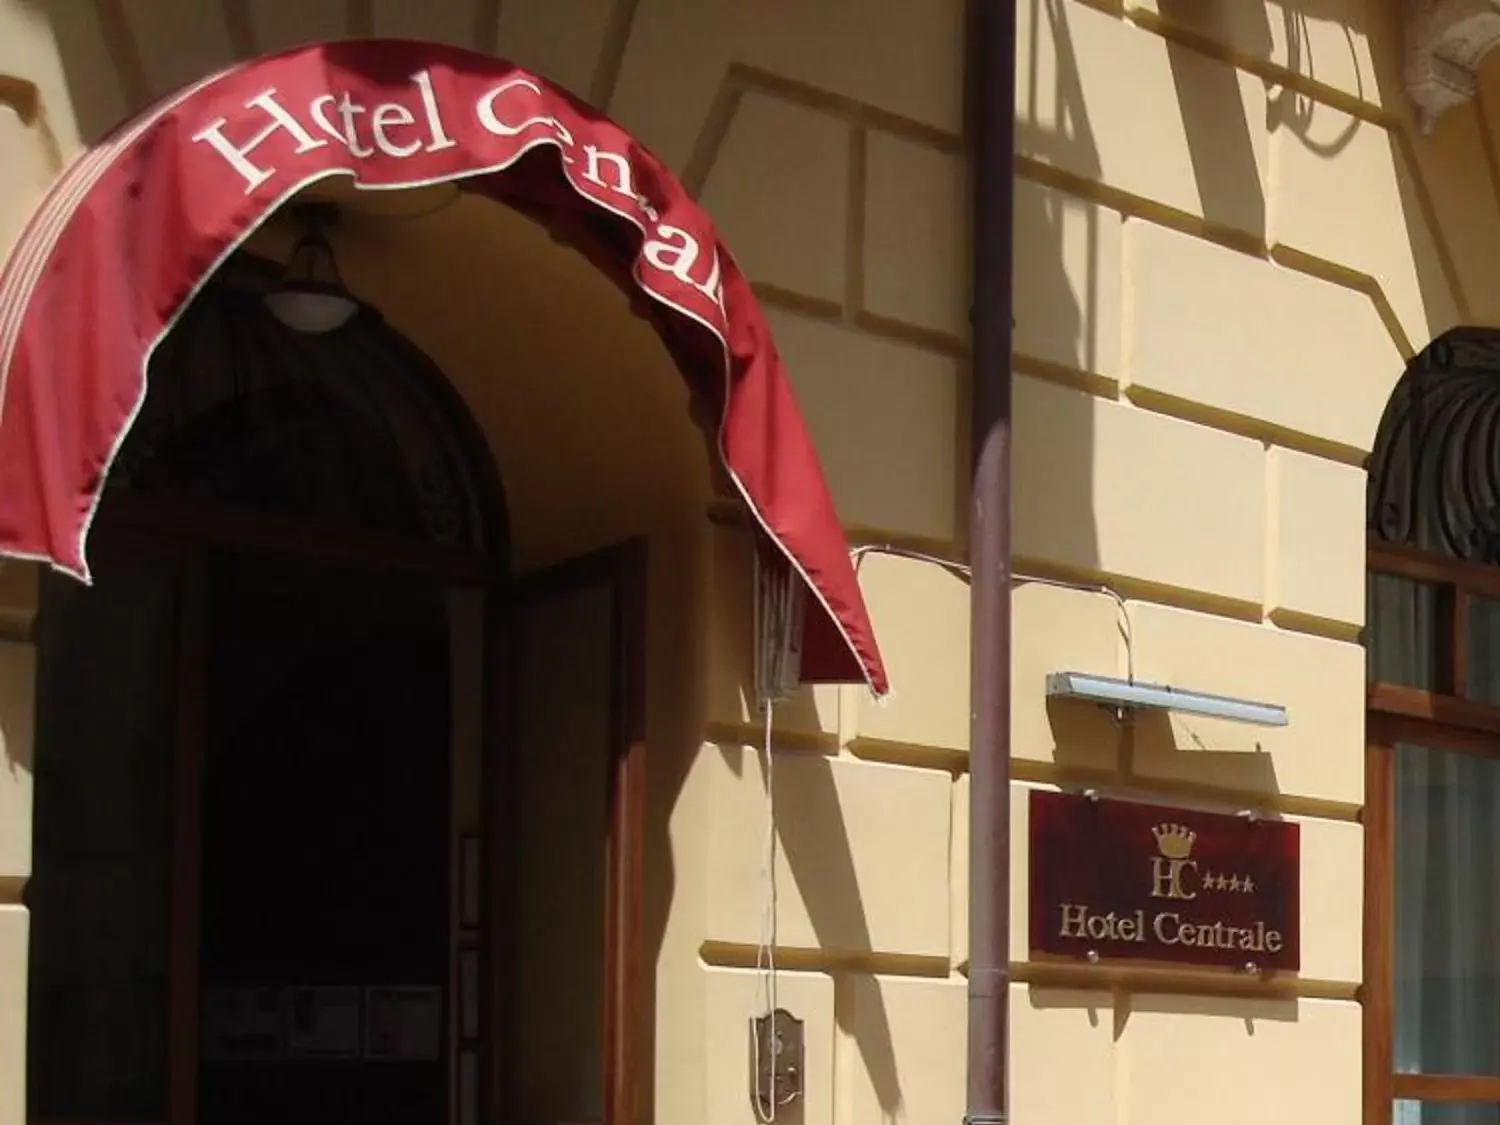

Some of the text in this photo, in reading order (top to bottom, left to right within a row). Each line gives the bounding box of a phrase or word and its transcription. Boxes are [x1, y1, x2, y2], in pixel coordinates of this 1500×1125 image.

[191, 69, 456, 196] Hotel
[1150, 857, 1197, 900] HC
[1059, 903, 1283, 952] Hotel Centrale
